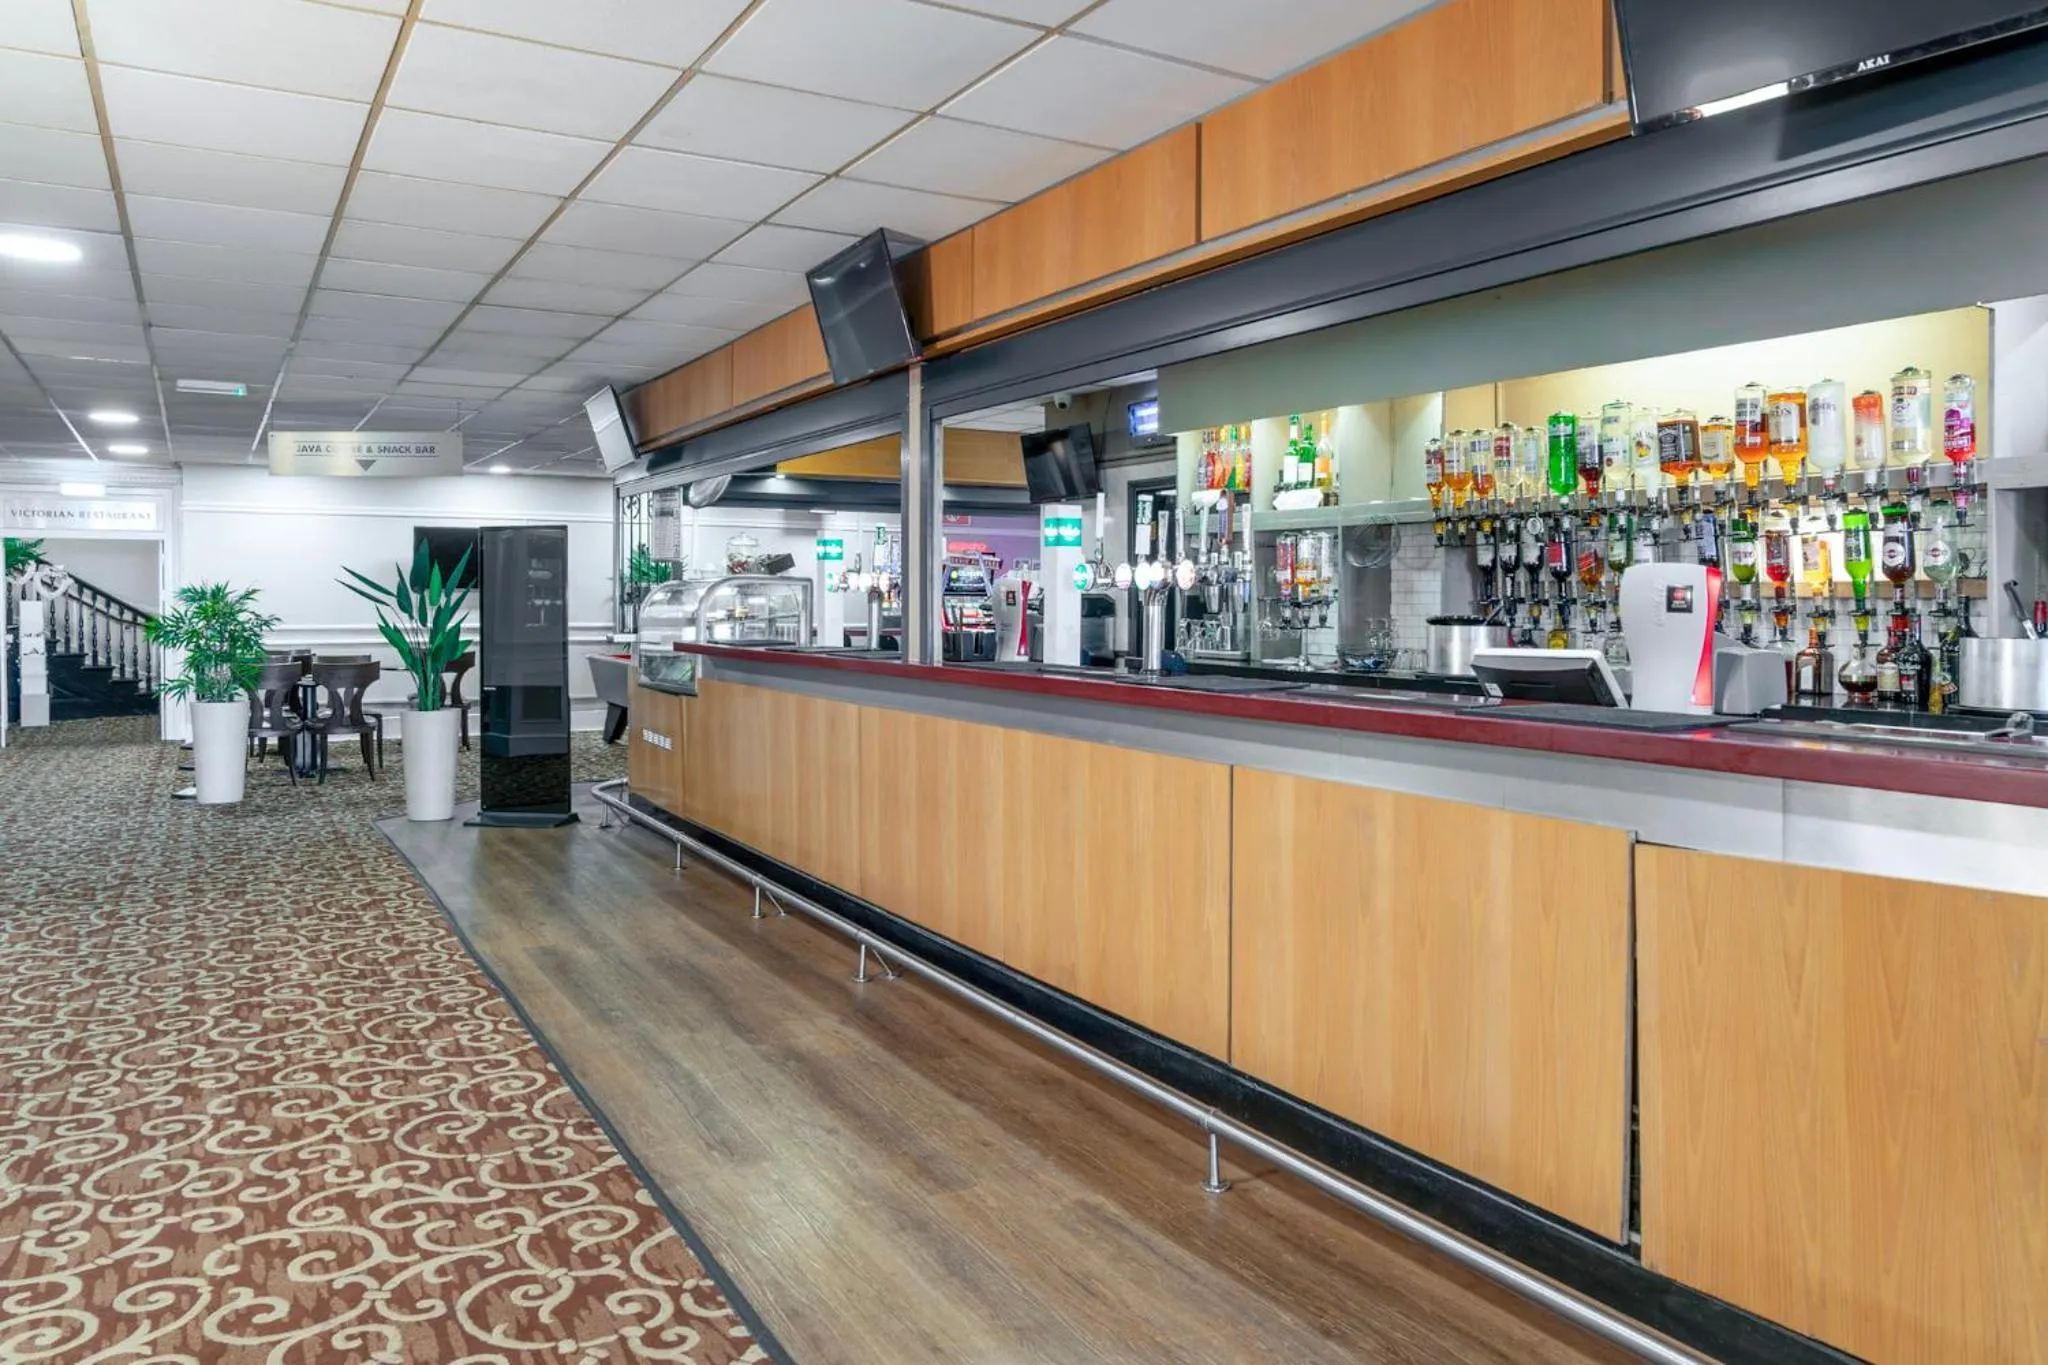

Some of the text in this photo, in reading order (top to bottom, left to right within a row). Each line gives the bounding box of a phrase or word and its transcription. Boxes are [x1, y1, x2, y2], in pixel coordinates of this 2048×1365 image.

[1857, 54, 1890, 72] AKAI
[296, 444, 322, 453] JAVA
[377, 445, 411, 455] SNACK
[414, 445, 436, 455] BAR
[10, 509, 152, 520] VICTORIAN RESTAURANT
